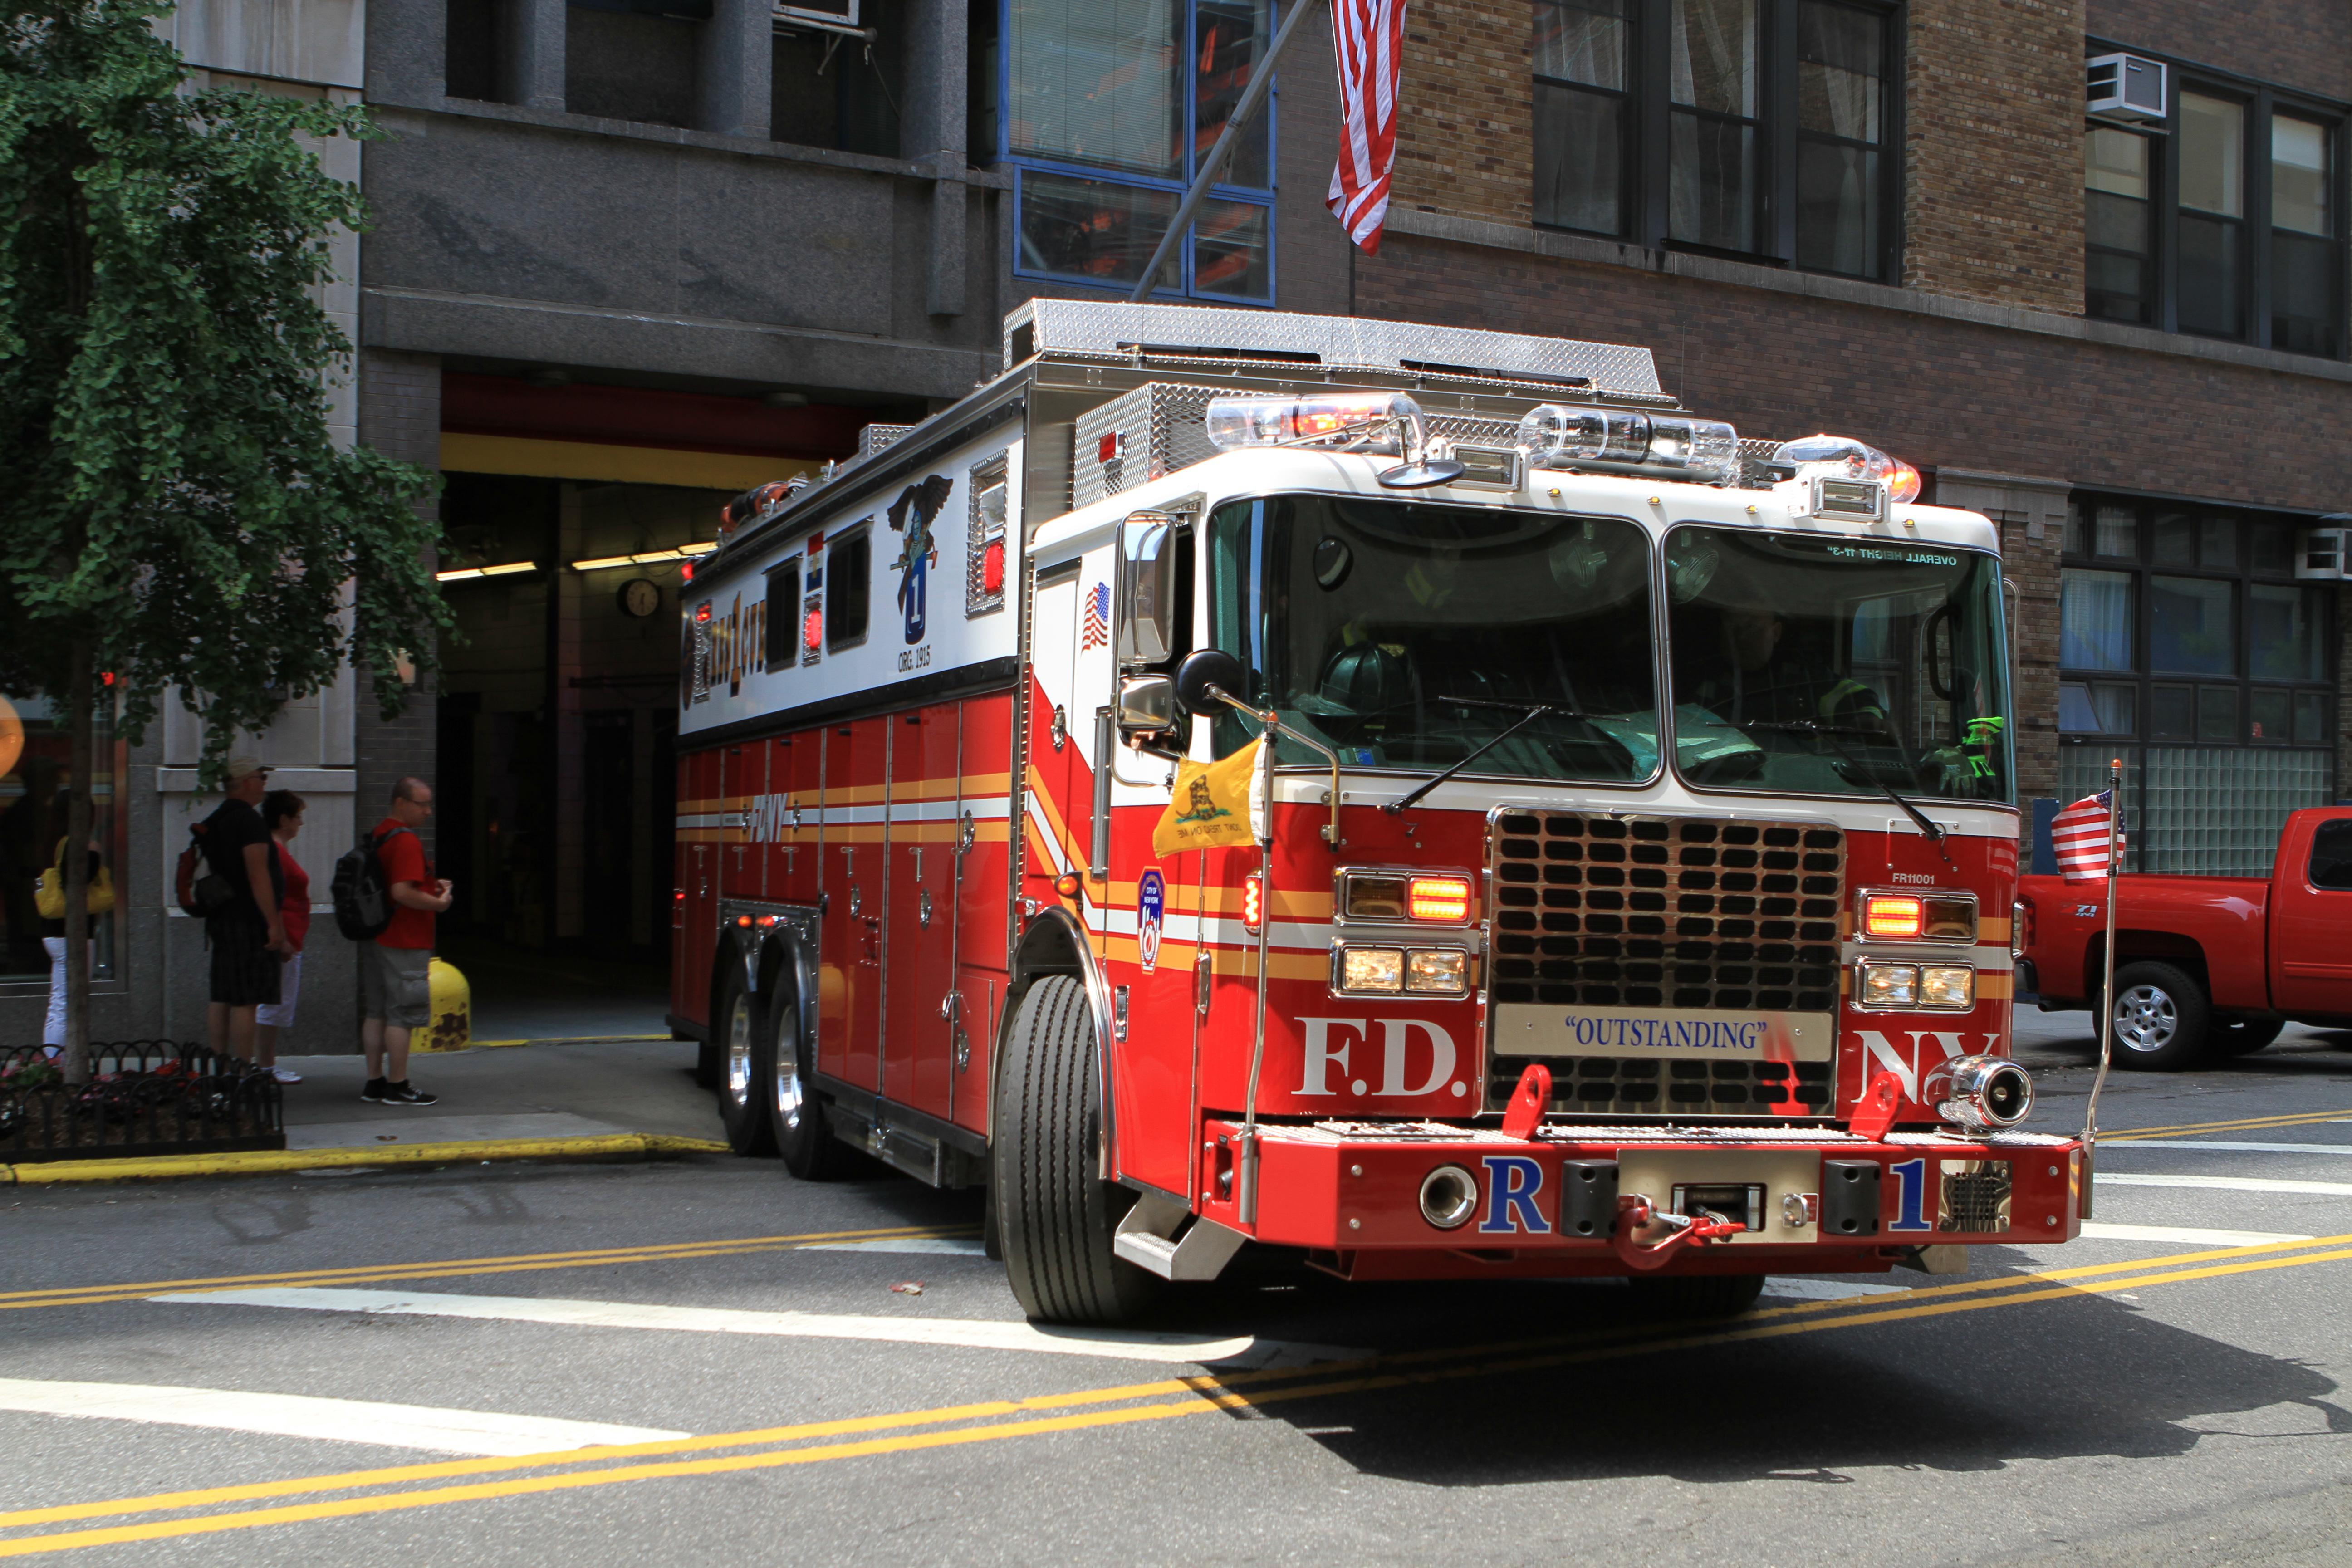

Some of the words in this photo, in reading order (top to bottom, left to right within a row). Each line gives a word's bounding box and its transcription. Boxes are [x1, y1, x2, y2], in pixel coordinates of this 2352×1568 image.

[911, 574, 921, 624] 1
[898, 650, 913, 672] ORG.
[916, 644, 930, 668] 1915
[1892, 873, 1935, 885] FR11001
[1291, 1017, 1466, 1098] F.D.
[1479, 1155, 1552, 1234] R
[1888, 1158, 1932, 1232] 1
